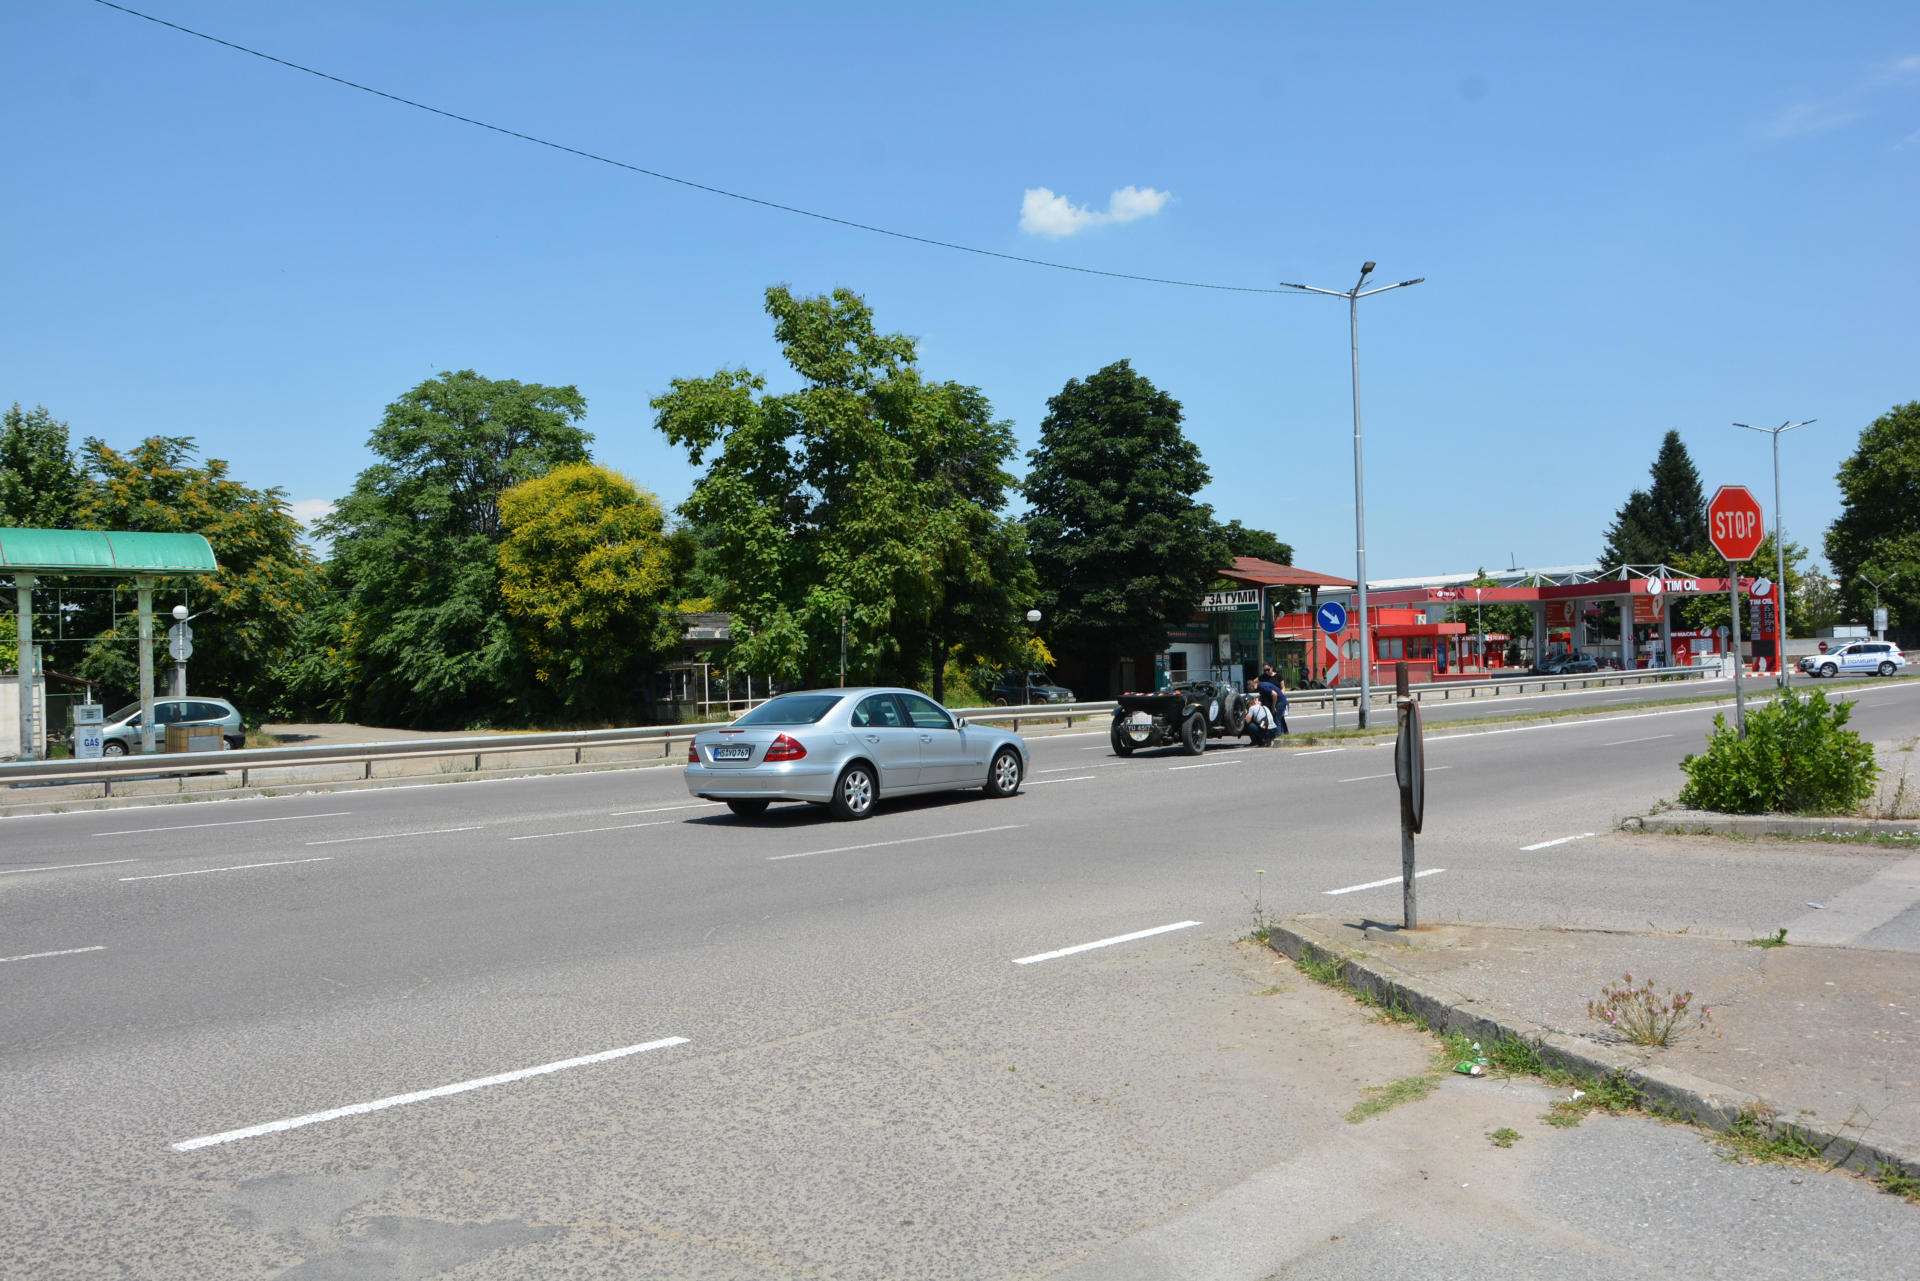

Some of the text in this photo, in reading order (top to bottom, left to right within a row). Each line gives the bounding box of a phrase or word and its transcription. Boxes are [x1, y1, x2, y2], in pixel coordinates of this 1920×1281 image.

[1716, 511, 1756, 539] STOP
[1665, 580, 1700, 591] TIM OIL
[1209, 593, 1222, 605] ЗА
[1225, 590, 1256, 604] ГУМИ
[84, 738, 100, 747] GAS
